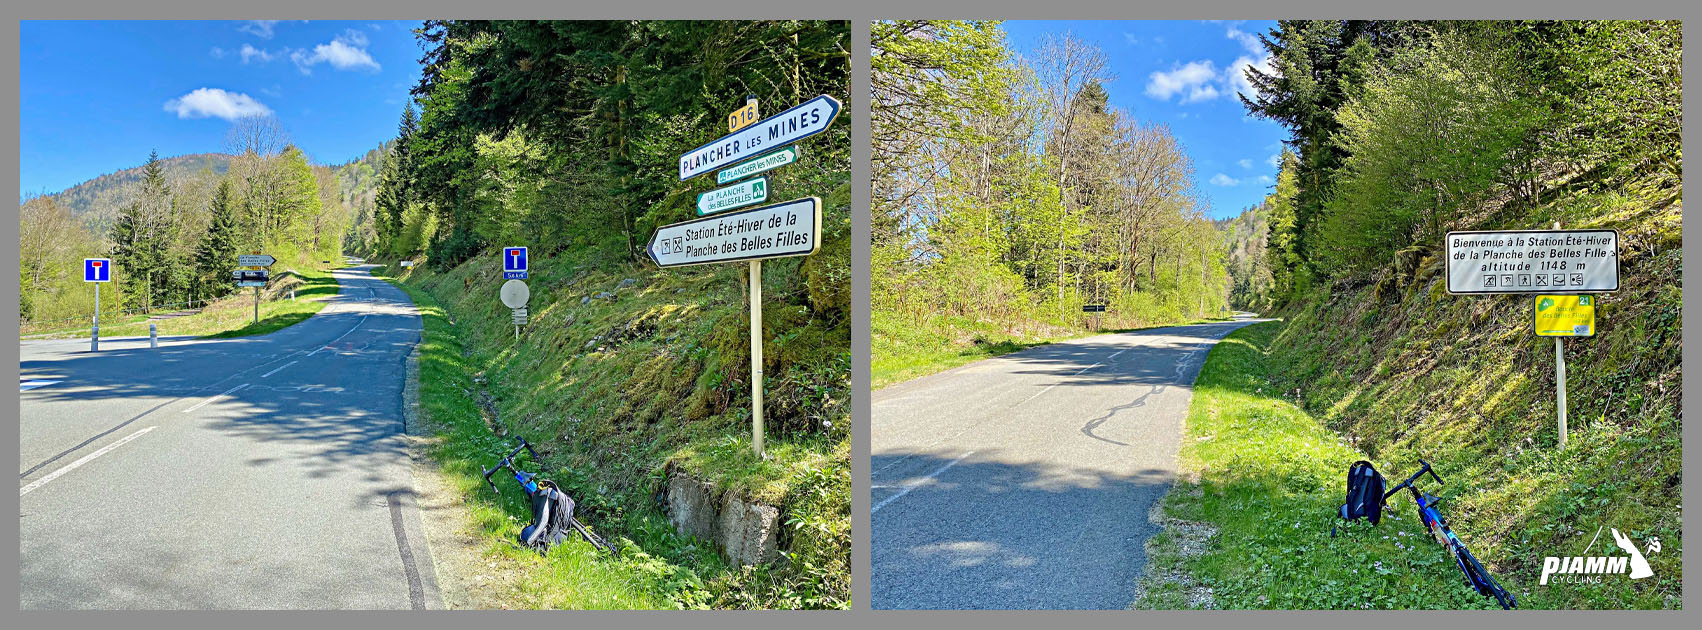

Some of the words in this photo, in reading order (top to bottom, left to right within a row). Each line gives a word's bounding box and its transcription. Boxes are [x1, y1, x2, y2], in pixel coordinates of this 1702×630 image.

[731, 115, 737, 129] D
[741, 106, 754, 124] 16
[683, 140, 740, 173] PLANCHER
[746, 137, 762, 149] LES
[768, 108, 820, 141] MINES
[726, 162, 757, 178] PLANCHER
[757, 160, 766, 169] les
[766, 153, 787, 167] MINES
[707, 194, 714, 202] La
[716, 185, 745, 199] PLANCHE
[707, 202, 716, 210] des
[716, 196, 735, 209] BELLES
[734, 193, 752, 205] FILLES
[685, 226, 715, 242] Station
[717, 219, 765, 237] Été-Hiver
[768, 214, 782, 229] de
[786, 211, 797, 226] la
[685, 242, 718, 258] Planche
[721, 240, 737, 254] des
[740, 237, 772, 251] Belles
[775, 232, 809, 248] Filles
[1453, 237, 1504, 250] Bienvenue
[1507, 236, 1513, 247] à
[1515, 236, 1525, 247] la
[1527, 236, 1564, 247] Station
[1565, 234, 1612, 246] Été-Hiver
[1453, 250, 1466, 260] de
[1469, 250, 1479, 260] la
[1482, 250, 1523, 260] Planche
[1528, 249, 1546, 258] des
[1549, 248, 1581, 258] Belles
[1481, 262, 1531, 272] altitude
[1540, 261, 1567, 271] 1148
[1576, 262, 1586, 271] m
[1579, 296, 1589, 305] 21
